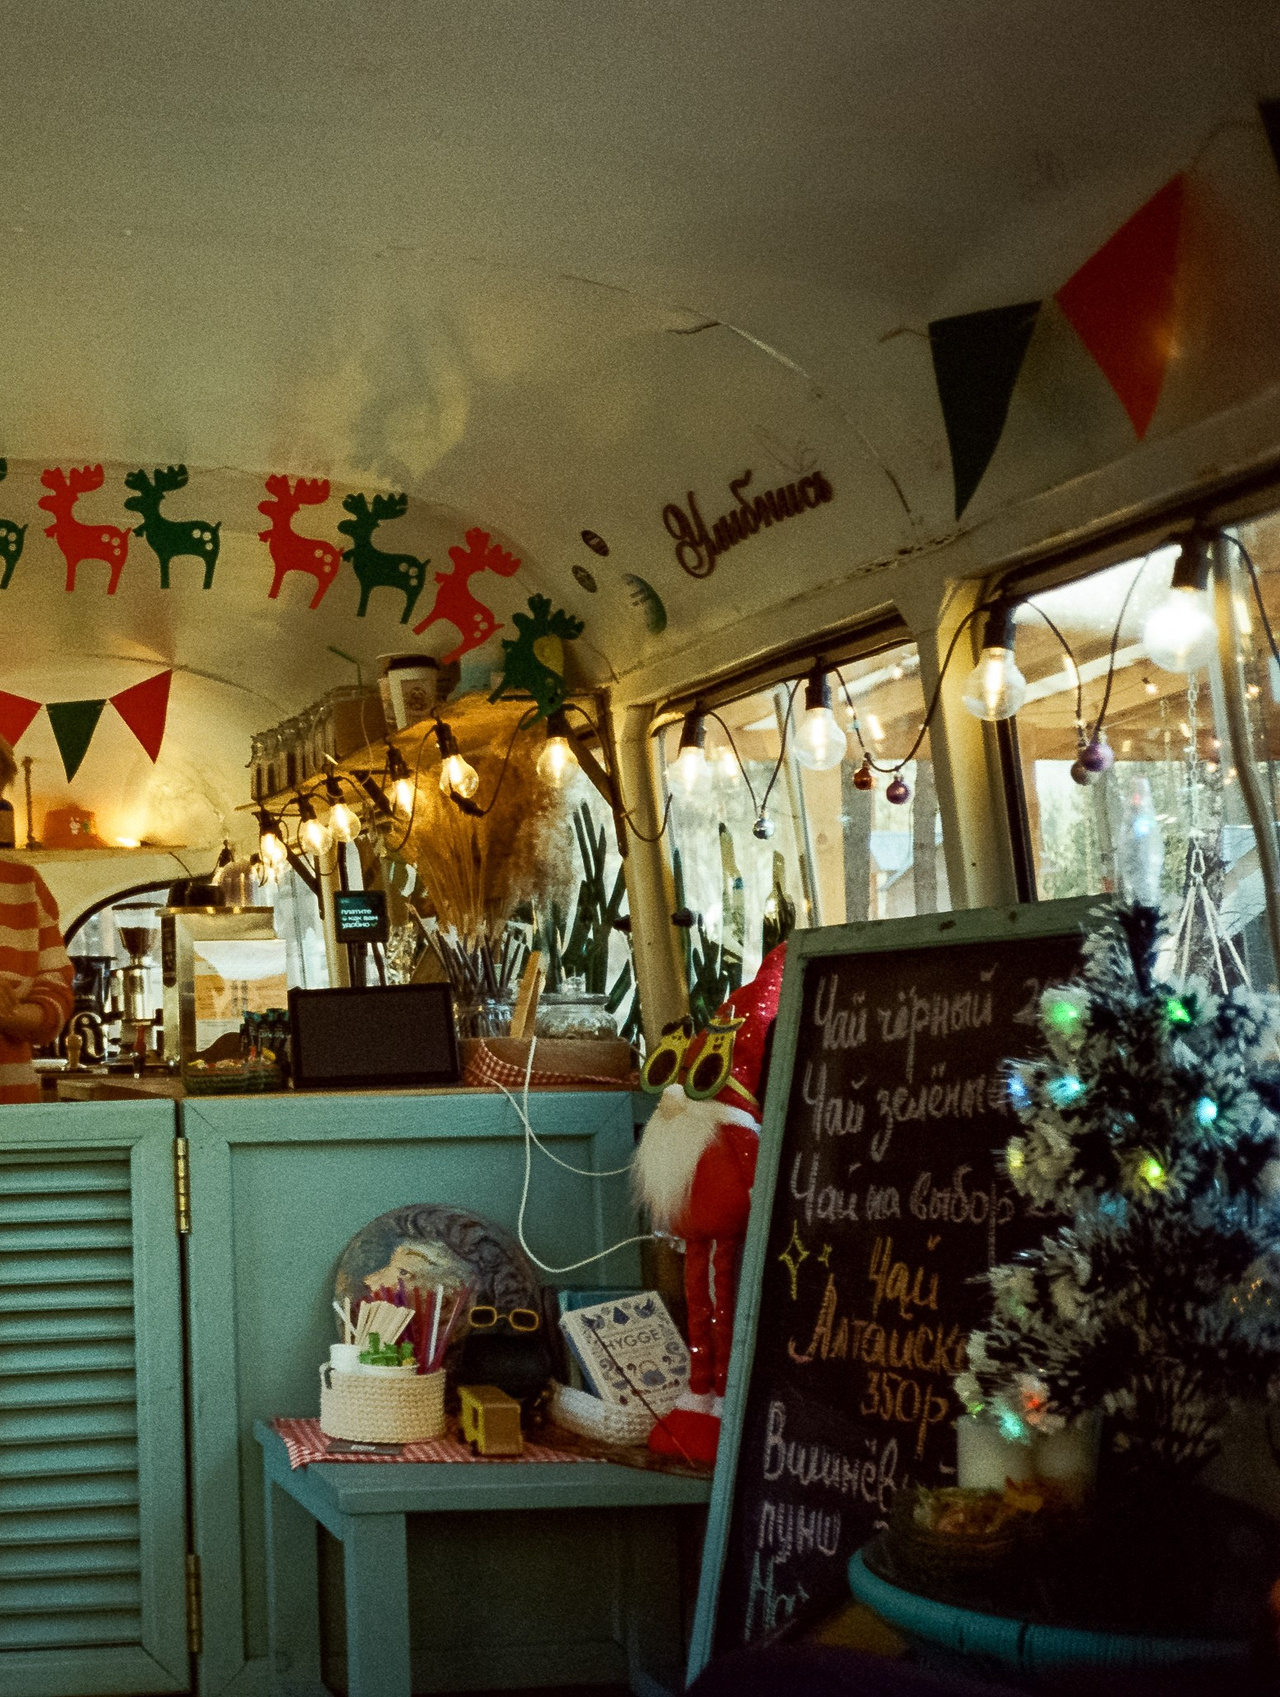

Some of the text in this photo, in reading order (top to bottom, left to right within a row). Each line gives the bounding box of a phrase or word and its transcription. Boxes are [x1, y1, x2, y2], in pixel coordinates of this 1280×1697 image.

[663, 468, 833, 579] Улыбнись
[815, 973, 868, 1050] Чай
[803, 1059, 868, 1140] Чай
[790, 1151, 862, 1226] Чай
[867, 1234, 943, 1320] Чай
[604, 1329, 660, 1351] HYGGE
[860, 1371, 950, 1457] 350р
